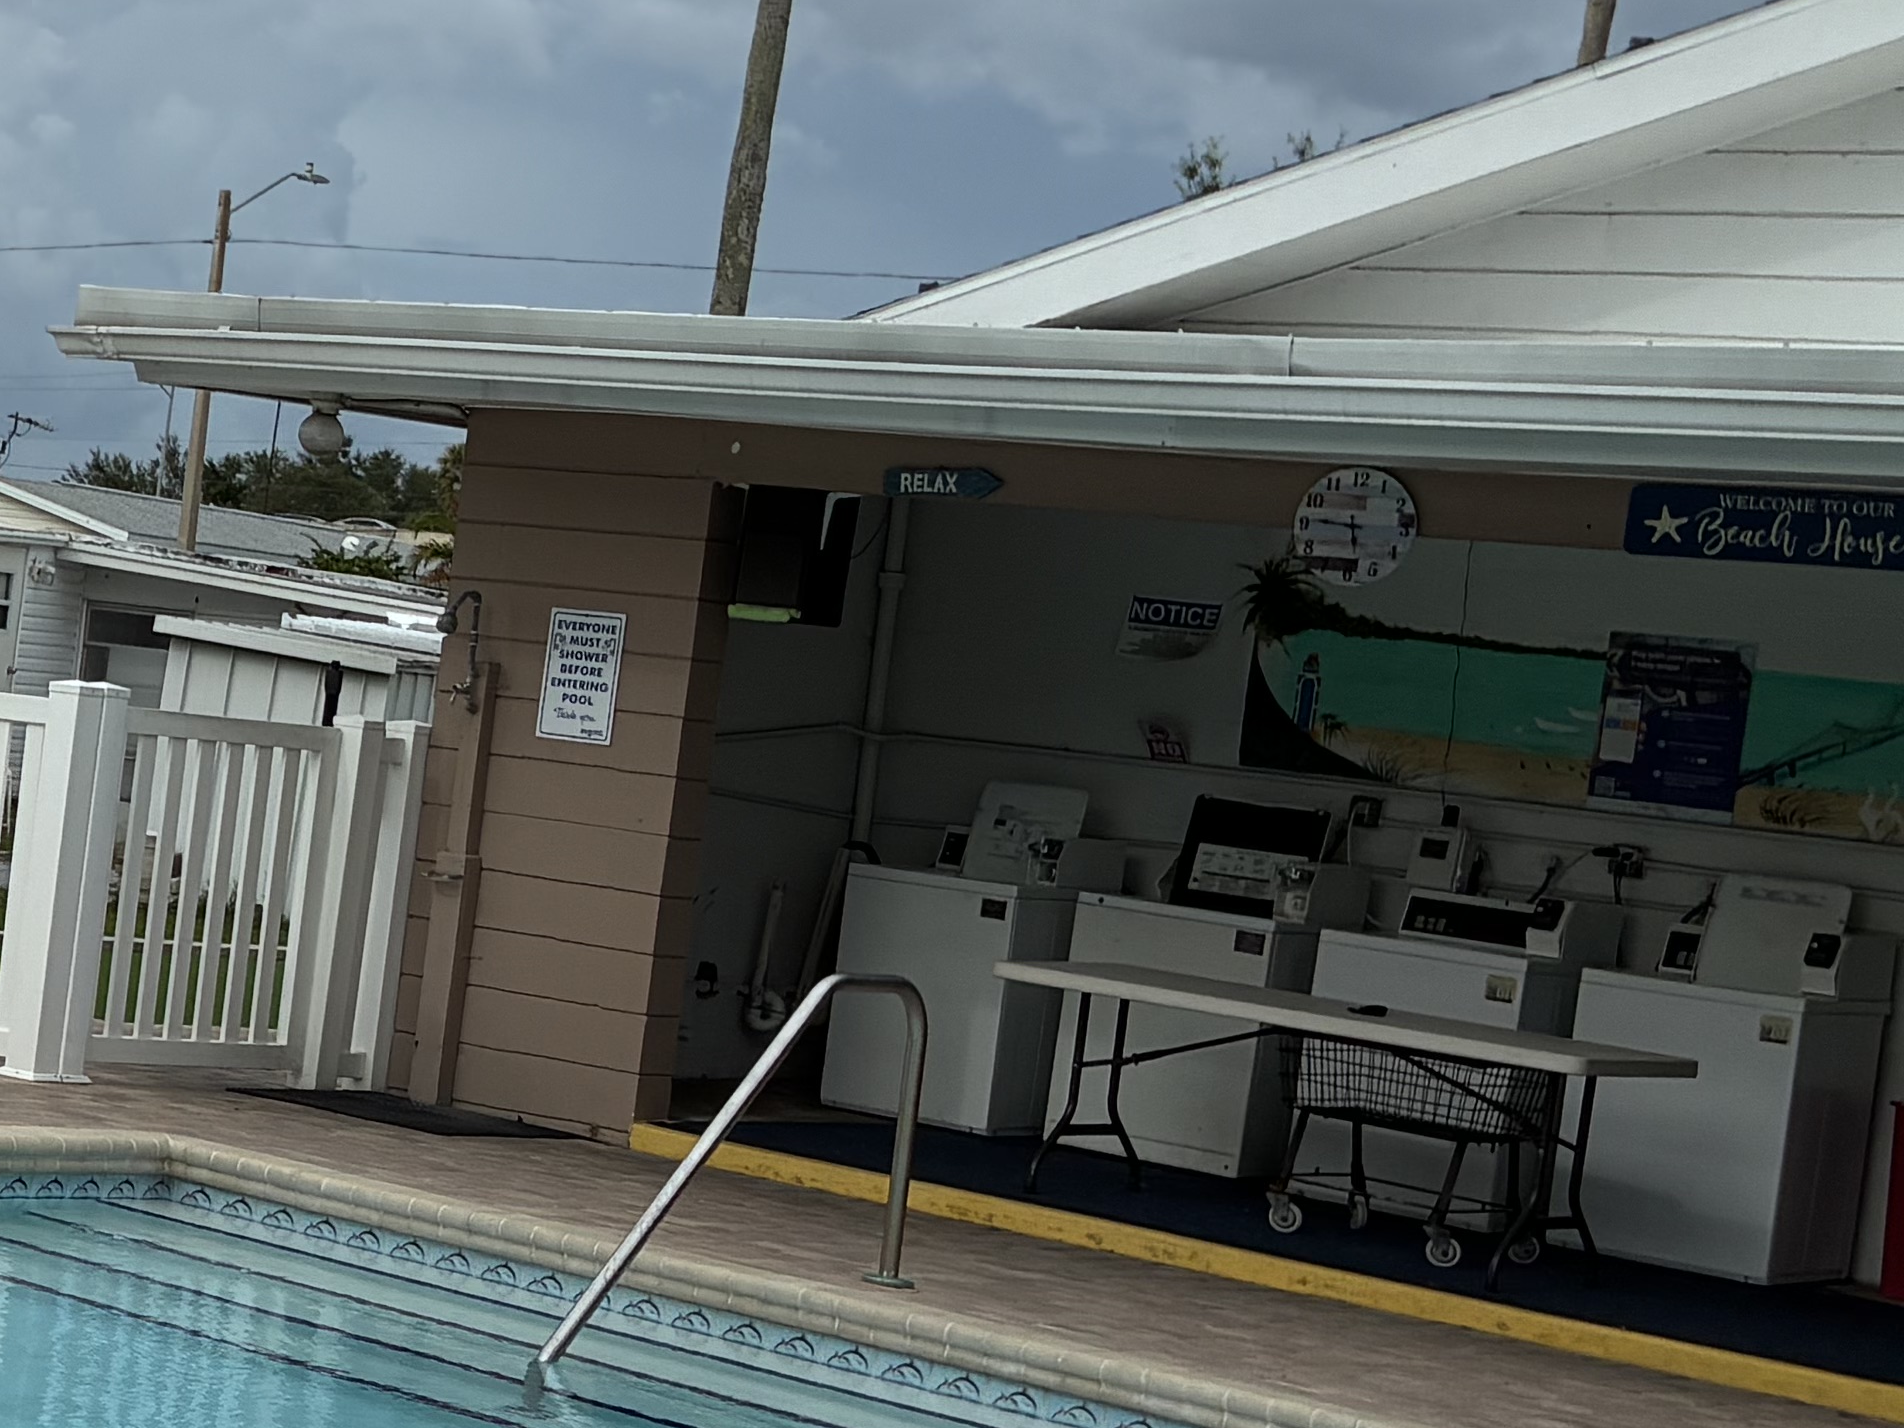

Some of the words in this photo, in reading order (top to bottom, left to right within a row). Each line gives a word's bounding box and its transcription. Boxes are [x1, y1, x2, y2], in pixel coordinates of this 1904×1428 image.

[899, 470, 959, 493] RELAX
[1326, 477, 1341, 491] 11
[1353, 471, 1370, 487] 12
[1381, 479, 1387, 494] 1
[1306, 493, 1324, 508] 10
[1396, 498, 1406, 513] 2
[1719, 493, 1815, 514] WELCOME
[1821, 499, 1847, 515] TO
[1852, 500, 1895, 518] OUR
[1299, 516, 1310, 531] 9
[1694, 506, 1798, 557] Beach
[1807, 516, 1904, 565] House
[1304, 539, 1314, 555] 8
[1130, 600, 1220, 627] NOTICE
[557, 619, 617, 635] EVERYONE
[569, 635, 602, 648] MUST
[558, 649, 609, 663] SHOWER
[560, 663, 604, 678] BEFORE
[550, 677, 609, 693] ENTERING
[561, 693, 594, 706] POOL
